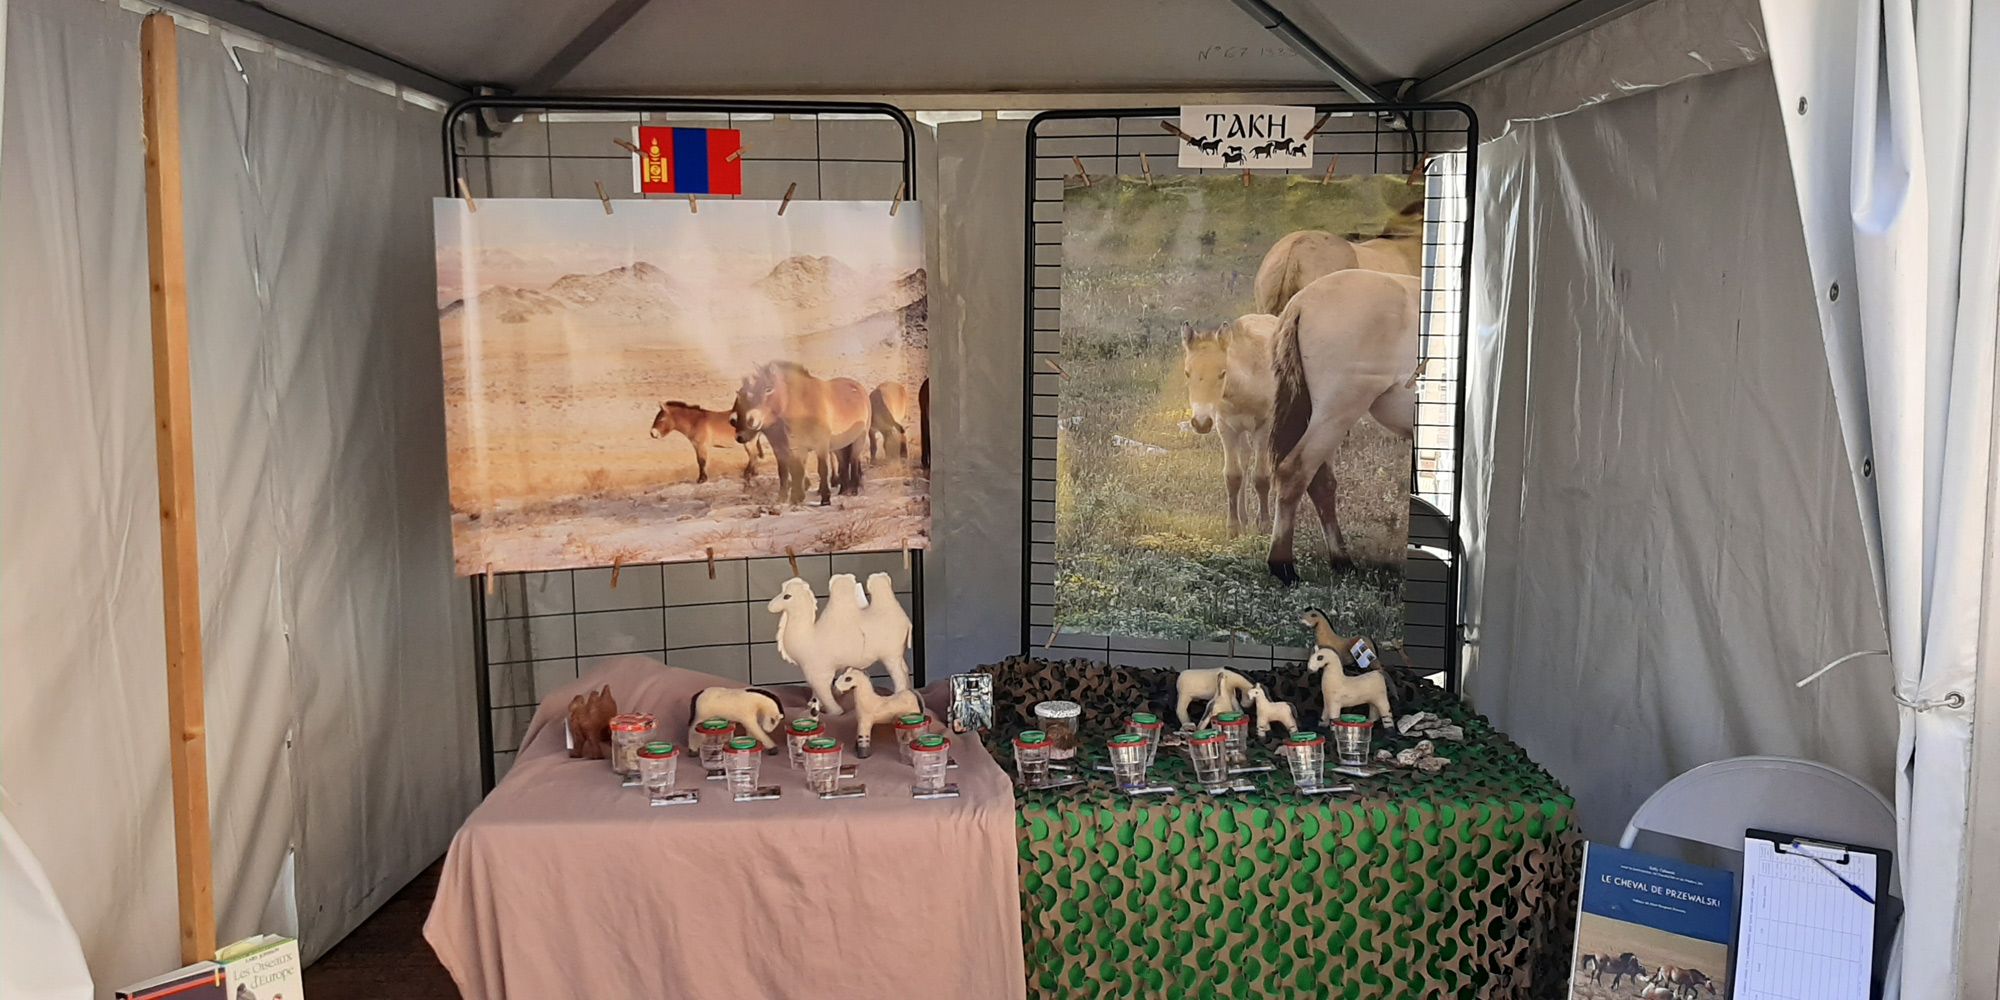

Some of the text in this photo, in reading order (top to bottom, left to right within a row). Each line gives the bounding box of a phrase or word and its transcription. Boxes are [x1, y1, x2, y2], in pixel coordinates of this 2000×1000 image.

[1205, 113, 1287, 139] TAKH
[1601, 874, 1612, 884] LE
[1614, 877, 1648, 892] CHEVAL
[1651, 885, 1664, 896] DE
[1665, 888, 1721, 908] PRZEWALSKI
[233, 969, 250, 981] Les
[252, 952, 293, 974] Oiseaux
[250, 966, 294, 989] d'Europe
